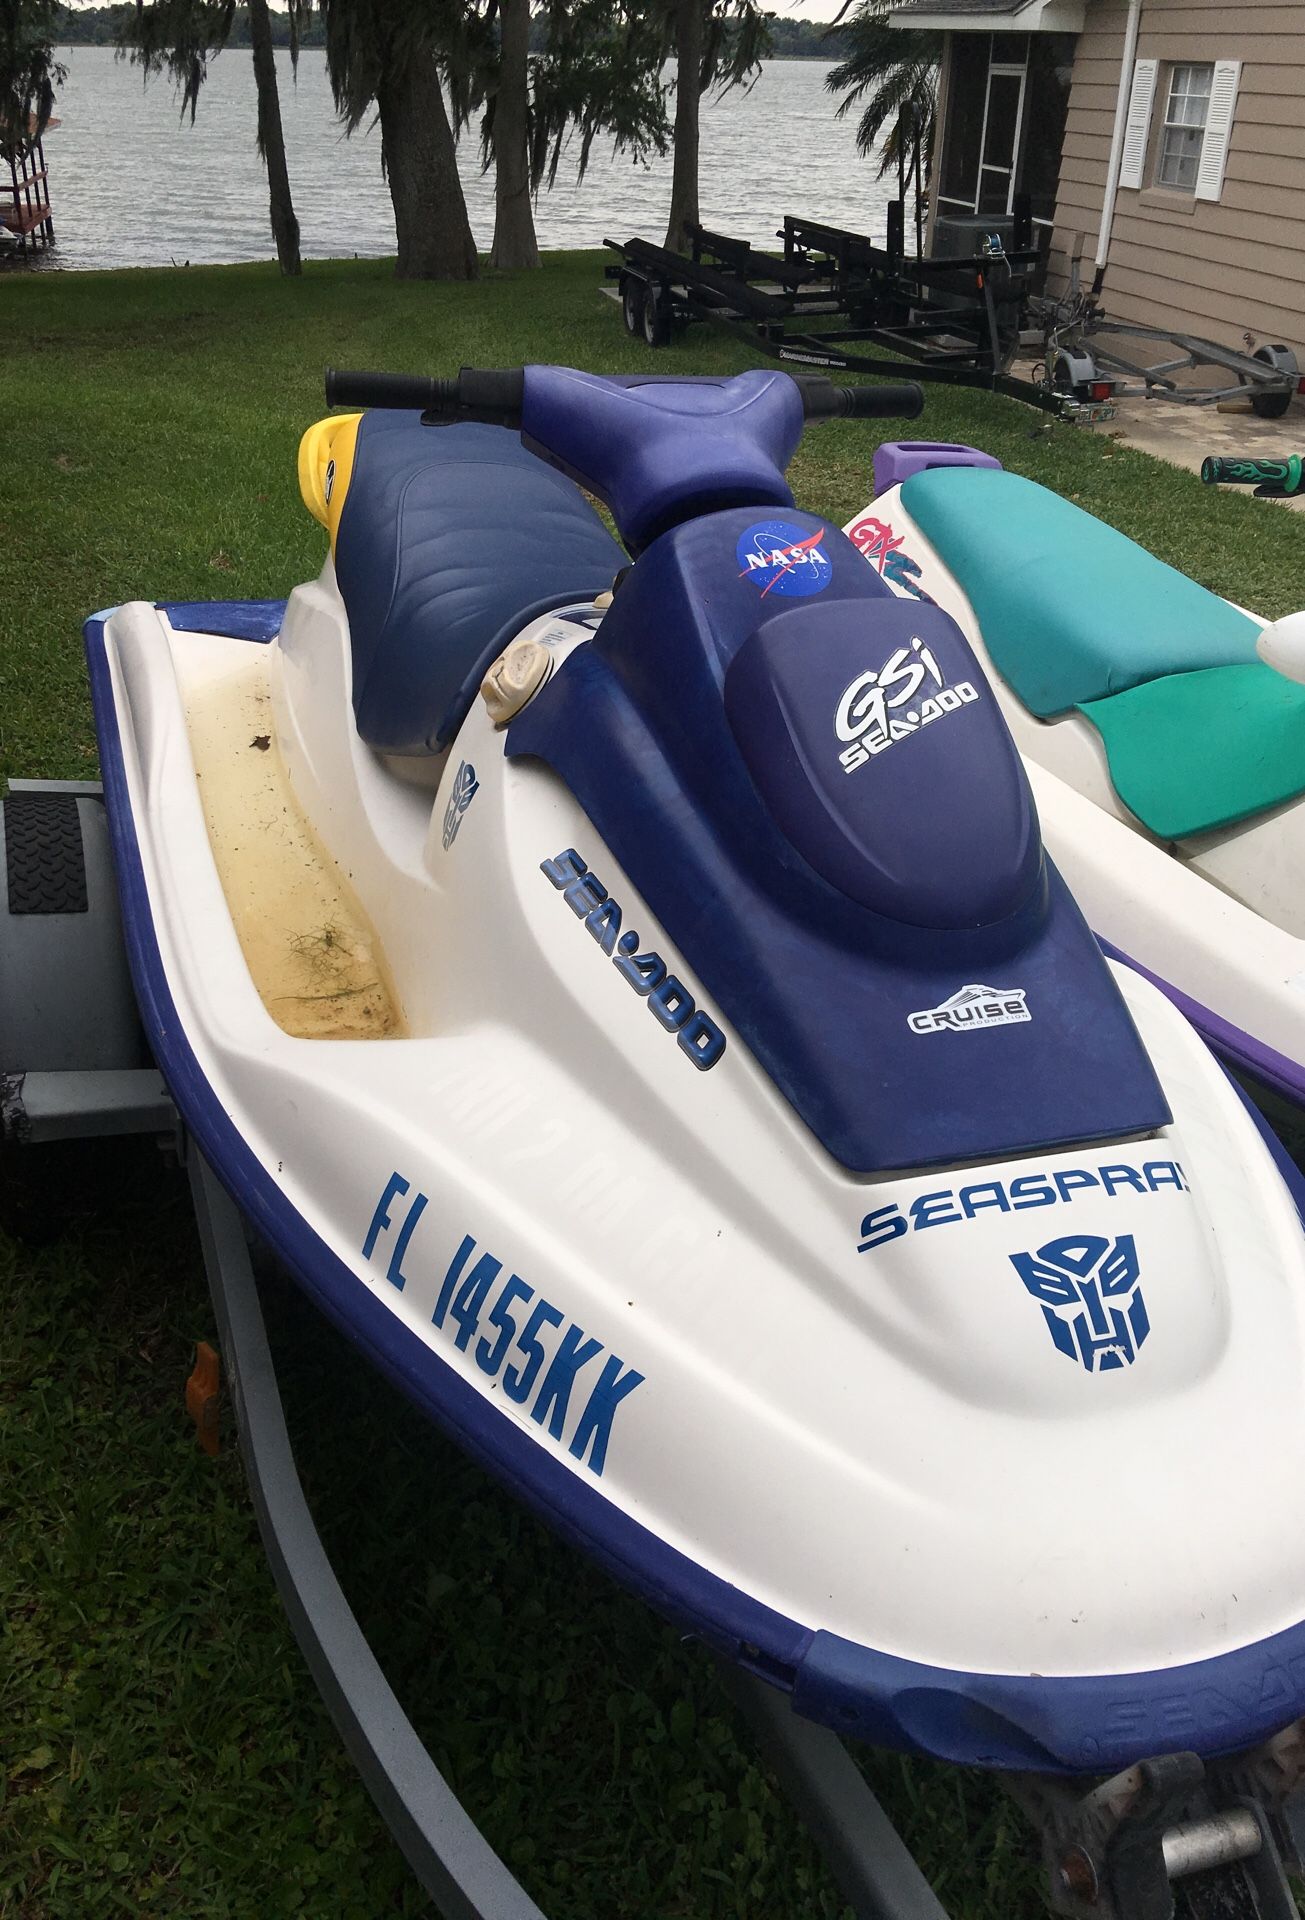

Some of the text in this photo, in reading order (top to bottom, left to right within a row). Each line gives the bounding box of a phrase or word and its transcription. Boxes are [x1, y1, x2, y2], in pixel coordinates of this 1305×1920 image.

[745, 548, 828, 571] NASA
[834, 636, 944, 742] GSi
[912, 1001, 1025, 1030] CRUISE
[962, 1014, 1028, 1027] PRODUCTION
[362, 1171, 429, 1293] FL
[431, 1233, 646, 1478] 1455KK
